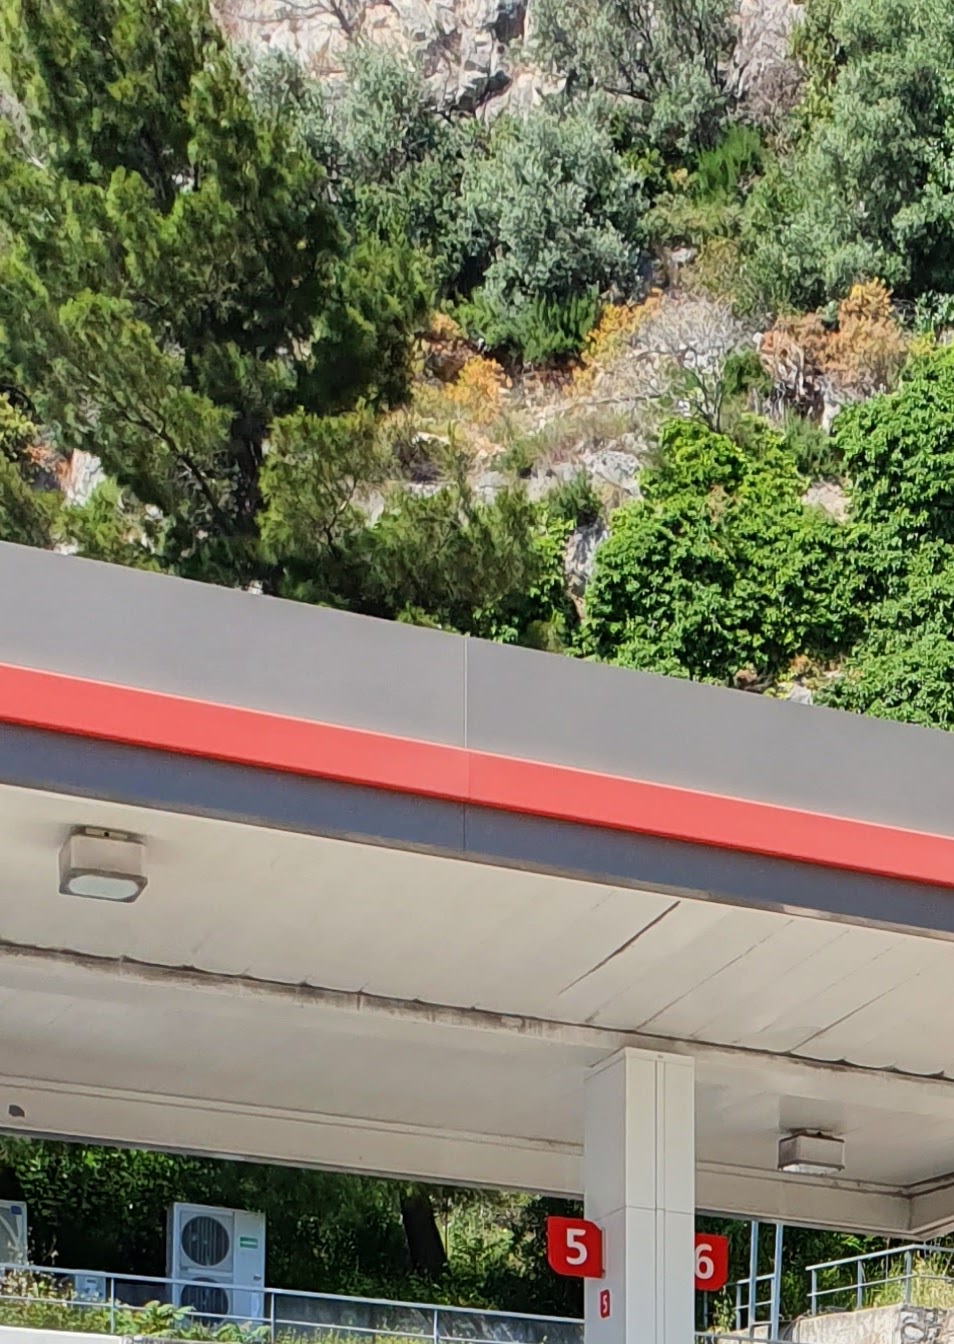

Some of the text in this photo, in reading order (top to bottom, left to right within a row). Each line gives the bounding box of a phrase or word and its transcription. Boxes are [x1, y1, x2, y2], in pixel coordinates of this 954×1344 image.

[566, 1228, 588, 1265] 5
[695, 1243, 715, 1280] 6
[602, 1295, 608, 1314] 5
